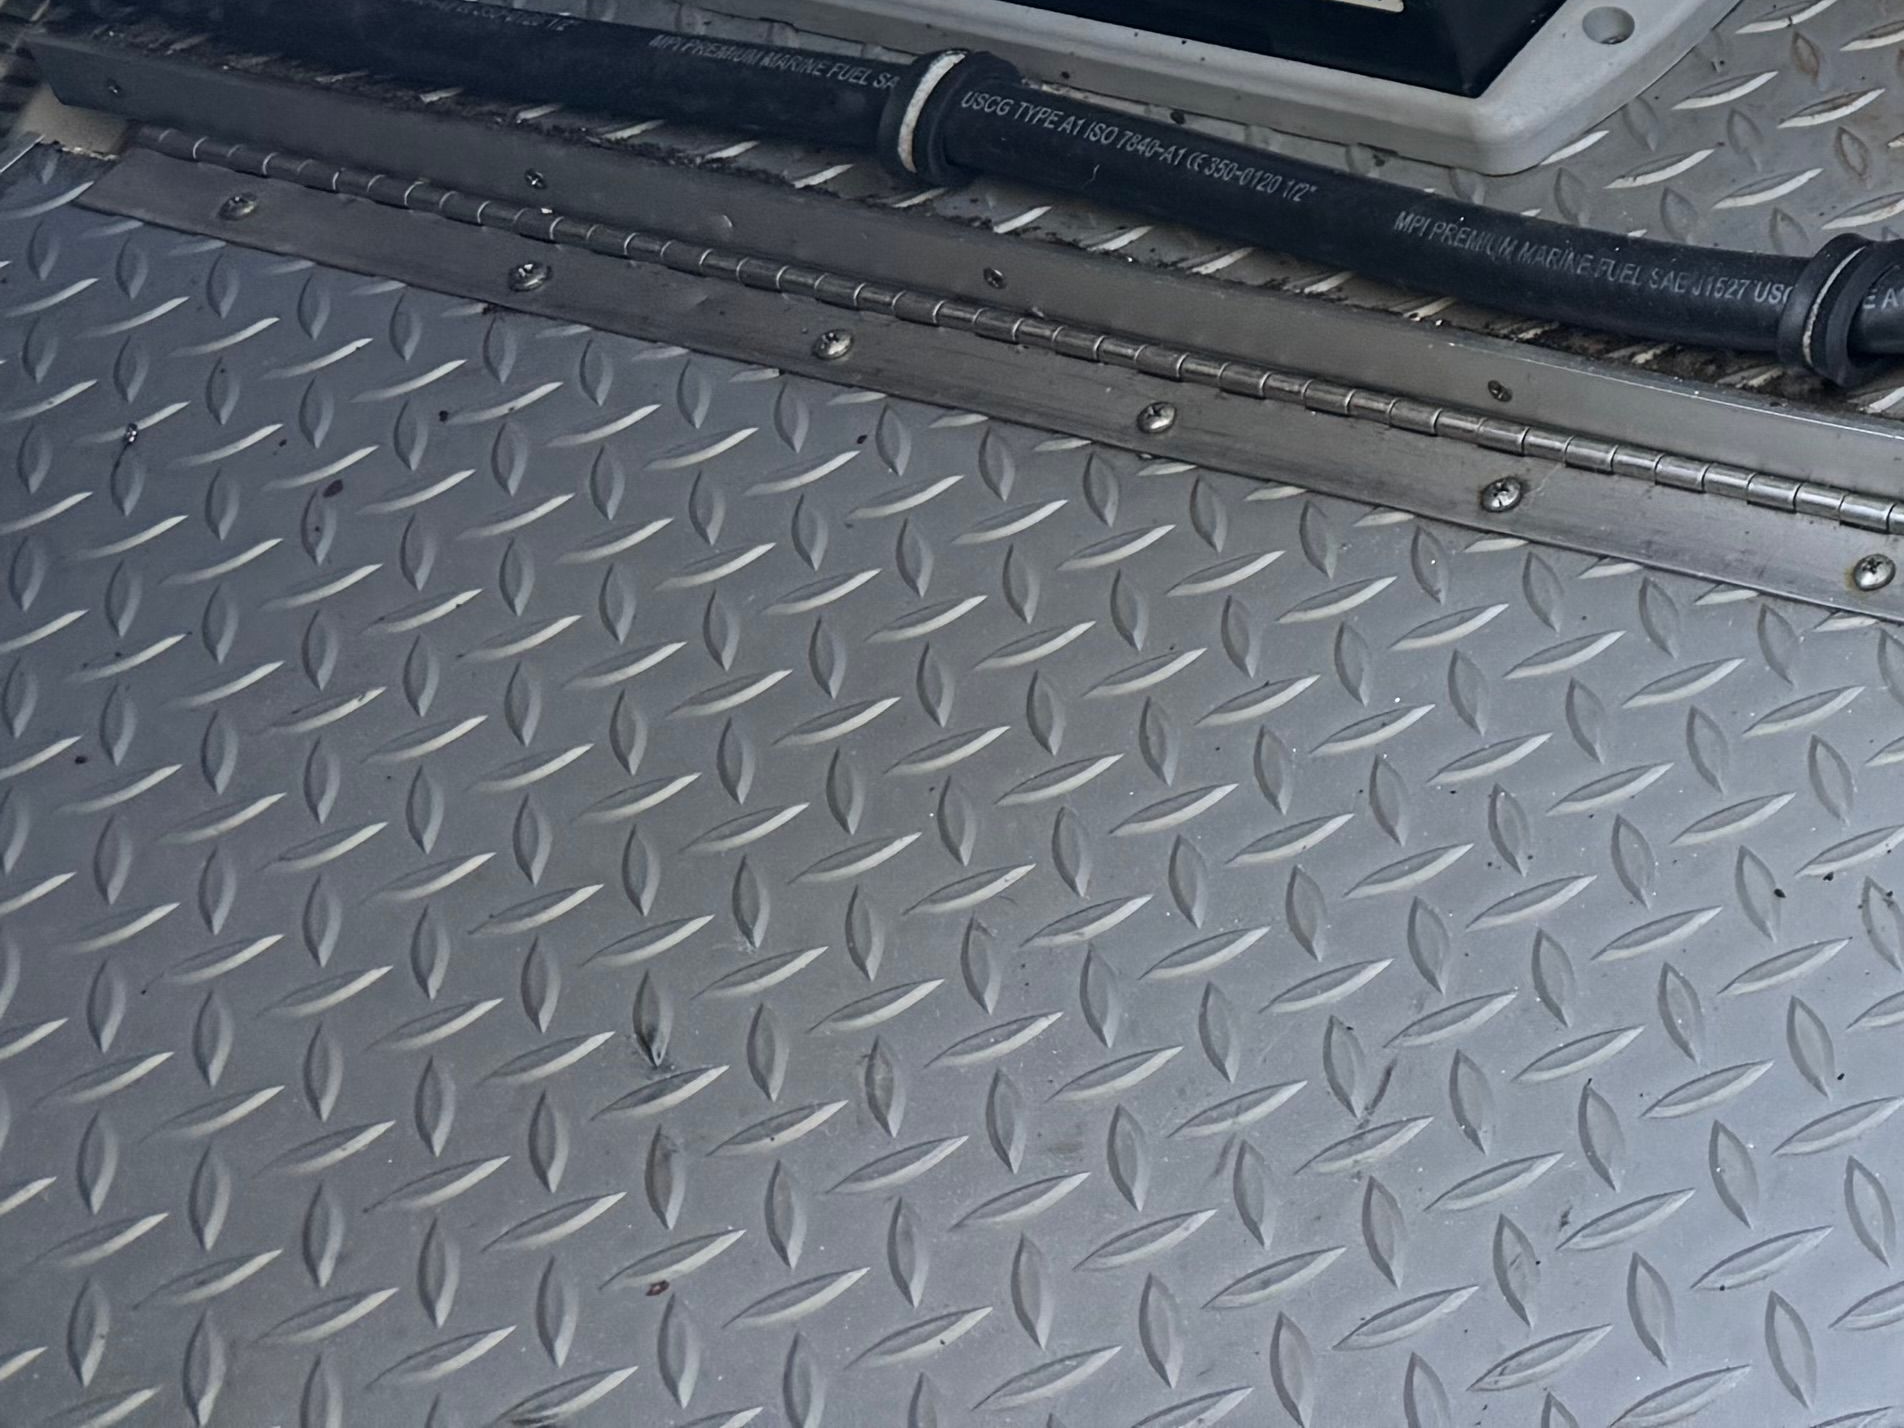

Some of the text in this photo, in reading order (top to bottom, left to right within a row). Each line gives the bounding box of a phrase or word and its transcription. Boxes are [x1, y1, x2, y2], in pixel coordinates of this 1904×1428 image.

[827, 62, 871, 86] FUEL
[961, 91, 1282, 195] USCG TYPE A1 ISO 7840-A1 350-0120
[1394, 211, 1429, 237] MPI
[1429, 221, 1518, 266] PREMIUM
[1518, 242, 1593, 276] MARINE
[1596, 256, 1642, 286] FUEL
[1649, 268, 1688, 295] SAE
